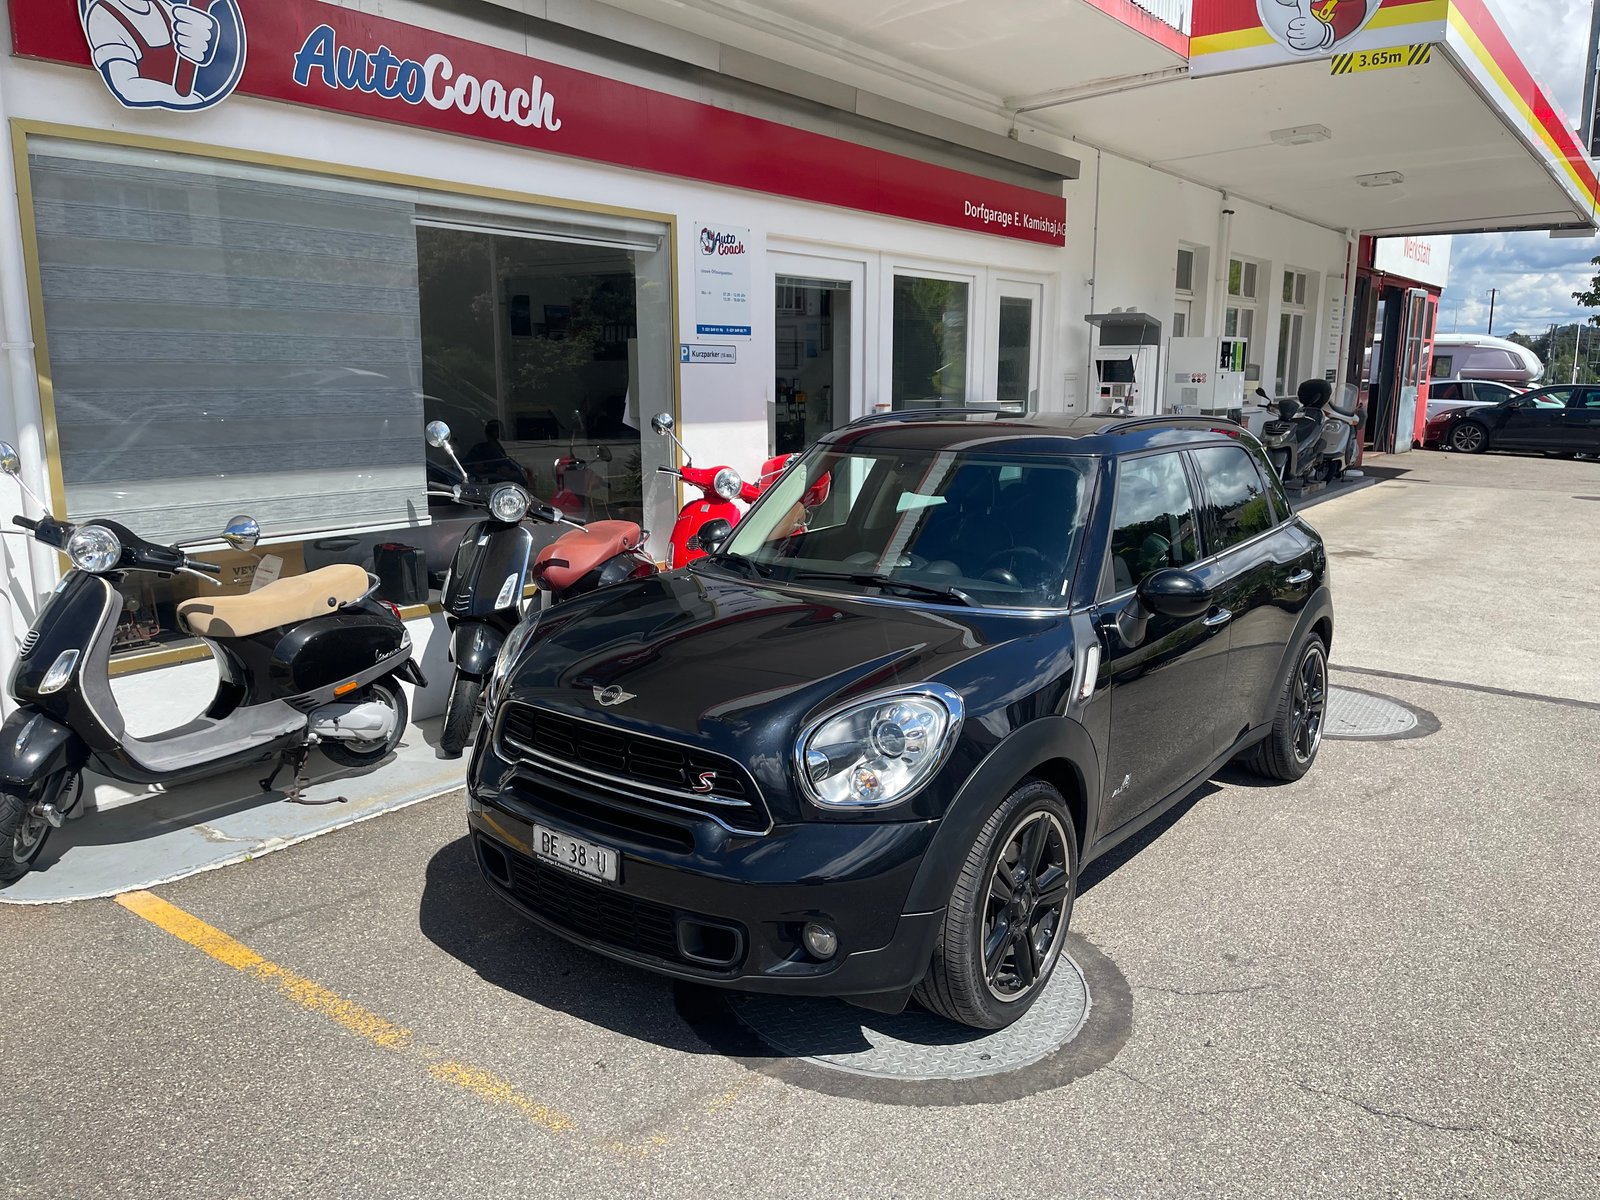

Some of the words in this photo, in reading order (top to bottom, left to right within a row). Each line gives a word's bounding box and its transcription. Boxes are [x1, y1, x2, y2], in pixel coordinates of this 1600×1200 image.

[1359, 52, 1402, 67] 3.65m
[293, 24, 561, 132] AutoCoach
[964, 200, 1012, 228] Dorfgarage
[1014, 212, 1022, 227] E.
[1023, 213, 1057, 237] Kamishaj
[1057, 223, 1066, 237] AG
[715, 232, 736, 245] Auto
[718, 241, 746, 256] Coach
[1403, 236, 1431, 265] Werkstatt
[681, 346, 689, 361] P
[691, 350, 720, 359] Kurzparker
[233, 565, 257, 576] VEV
[693, 772, 716, 793] S
